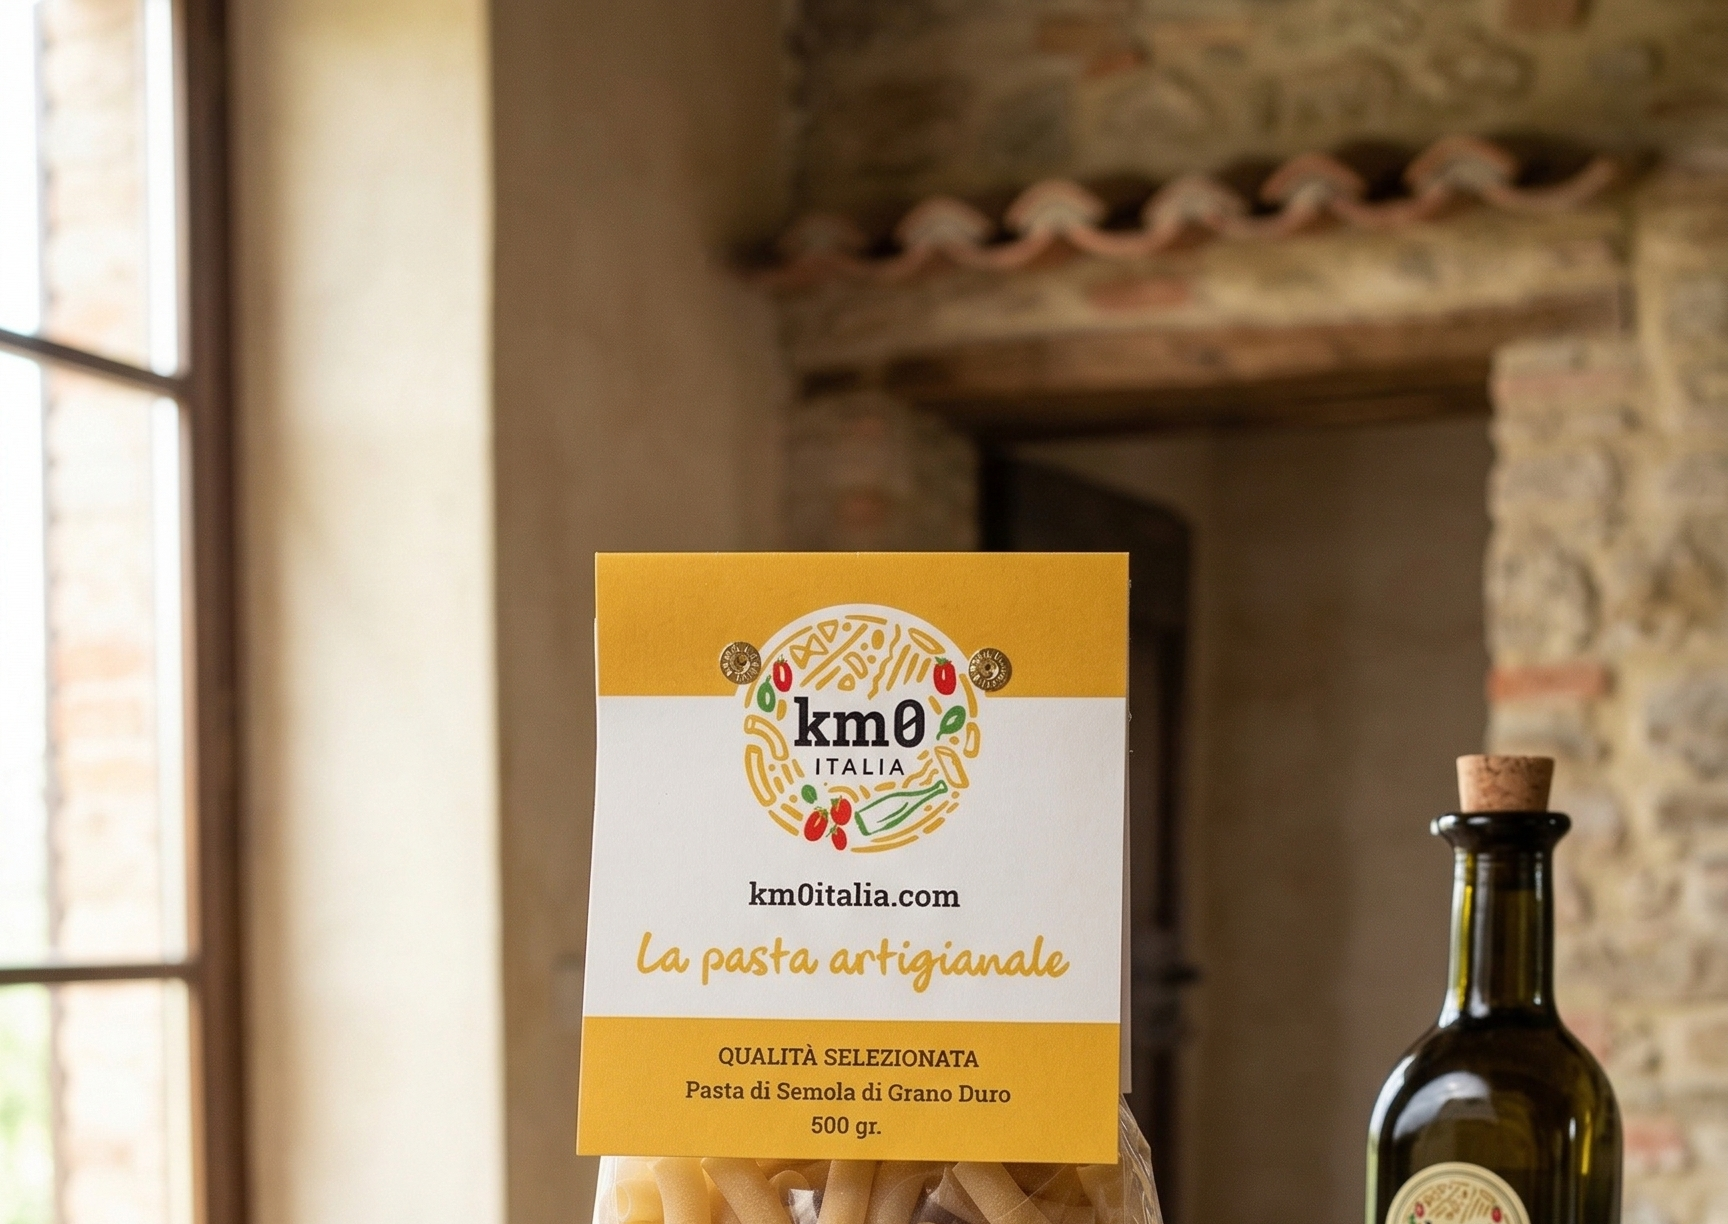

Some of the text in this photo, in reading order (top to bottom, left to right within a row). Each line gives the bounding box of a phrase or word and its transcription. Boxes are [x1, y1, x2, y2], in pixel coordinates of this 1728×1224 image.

[793, 696, 926, 748] km0
[815, 757, 905, 776] ITALIA
[748, 881, 961, 908] km0italia.com
[635, 931, 1070, 994] La pasta artigianale
[718, 1043, 980, 1068] QUALITÀ SELEZIONATA
[685, 1080, 1011, 1103] Pasta di Semola di Grano Duro
[811, 1116, 882, 1140] 500 gr.
